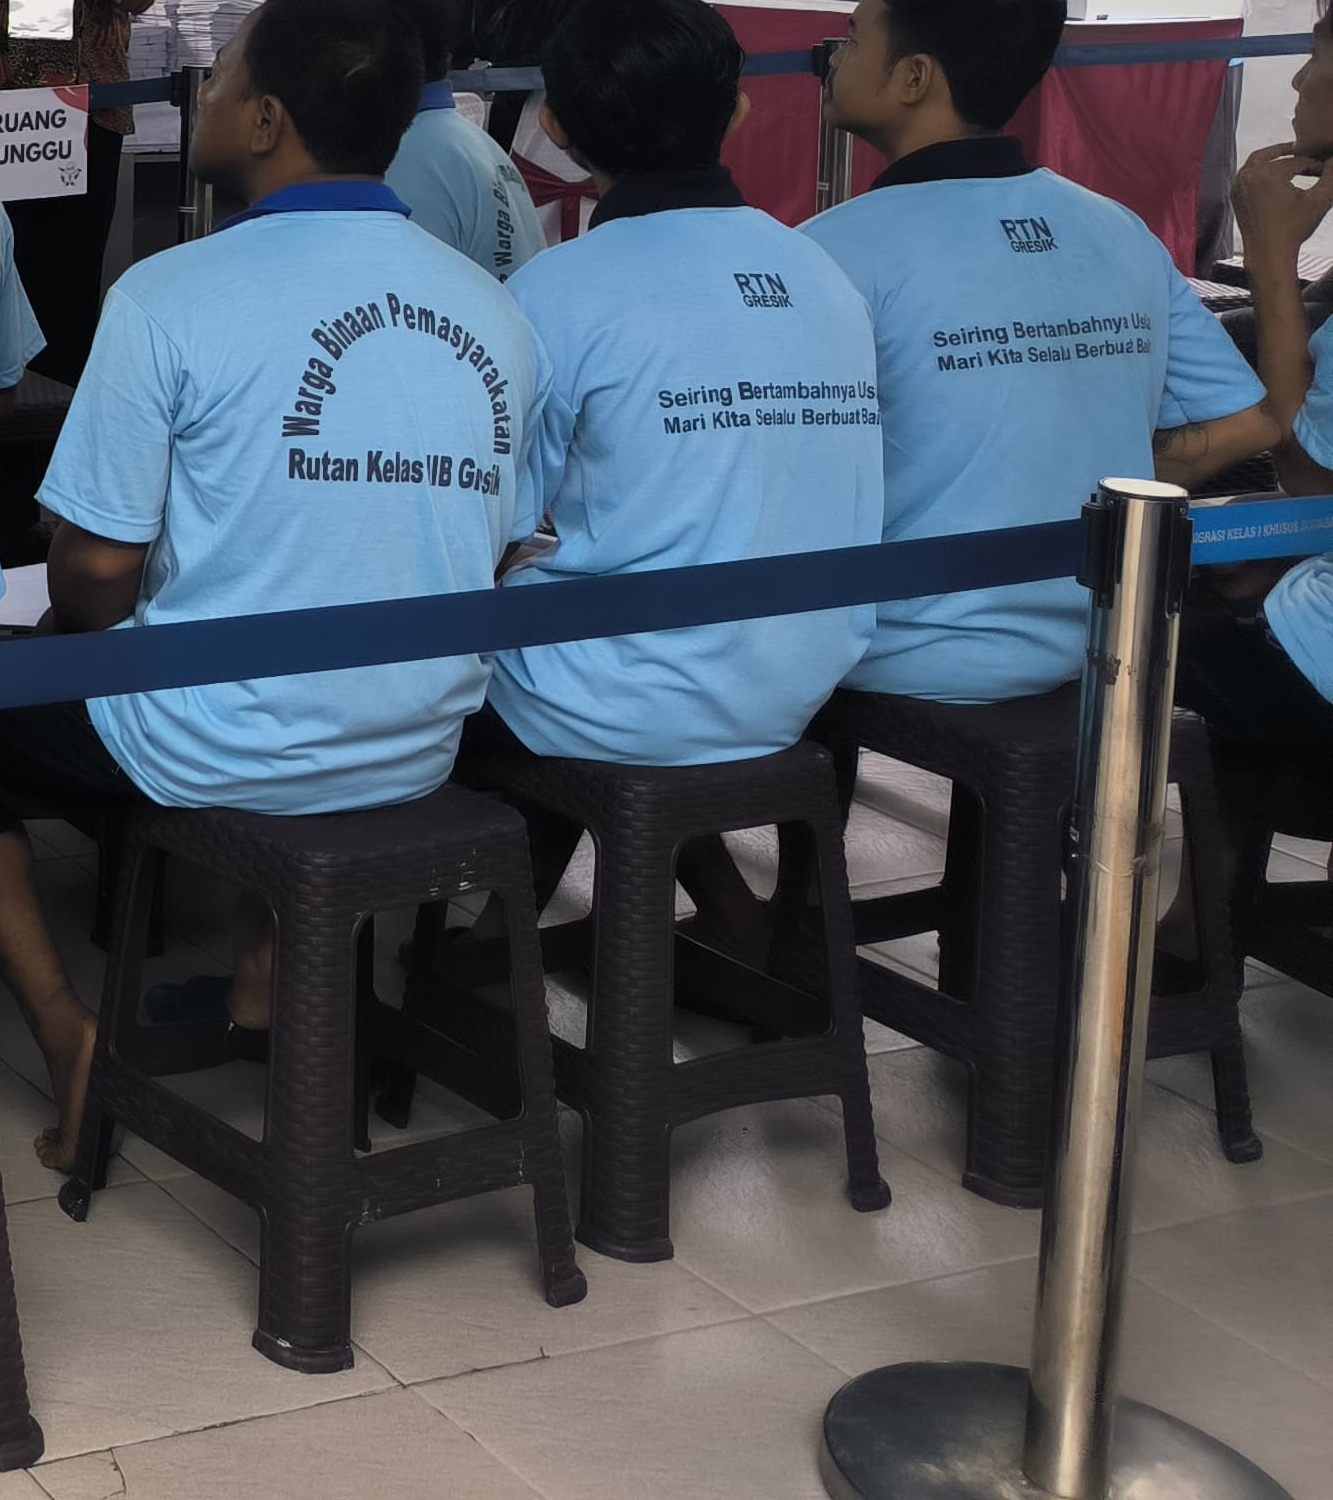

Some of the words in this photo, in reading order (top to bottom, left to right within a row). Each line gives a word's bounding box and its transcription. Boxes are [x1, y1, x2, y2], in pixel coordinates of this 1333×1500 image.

[1000, 216, 1052, 241] RTN
[1010, 237, 1060, 254] GRESIK
[733, 272, 788, 295] RTN
[742, 294, 794, 308] GRESIK
[933, 325, 1009, 348] Seiring
[937, 352, 983, 372] Mari
[988, 348, 1023, 367] Kita
[282, 357, 337, 437] Warga
[311, 301, 386, 361] Binaan
[386, 292, 512, 455] Pemasyarakatan
[658, 386, 733, 409] Seiring
[737, 380, 856, 403] Bertambahnya
[857, 380, 876, 400] Us
[663, 414, 706, 435] Mari
[712, 410, 751, 430] Kita
[755, 408, 796, 426] Selalu
[801, 408, 861, 426] Berbuat
[861, 407, 881, 426] Bai
[288, 447, 359, 482] Rutan
[366, 450, 424, 484] Kelas
[458, 457, 501, 496] Grsik
[1227, 525, 1257, 541] KELAS
